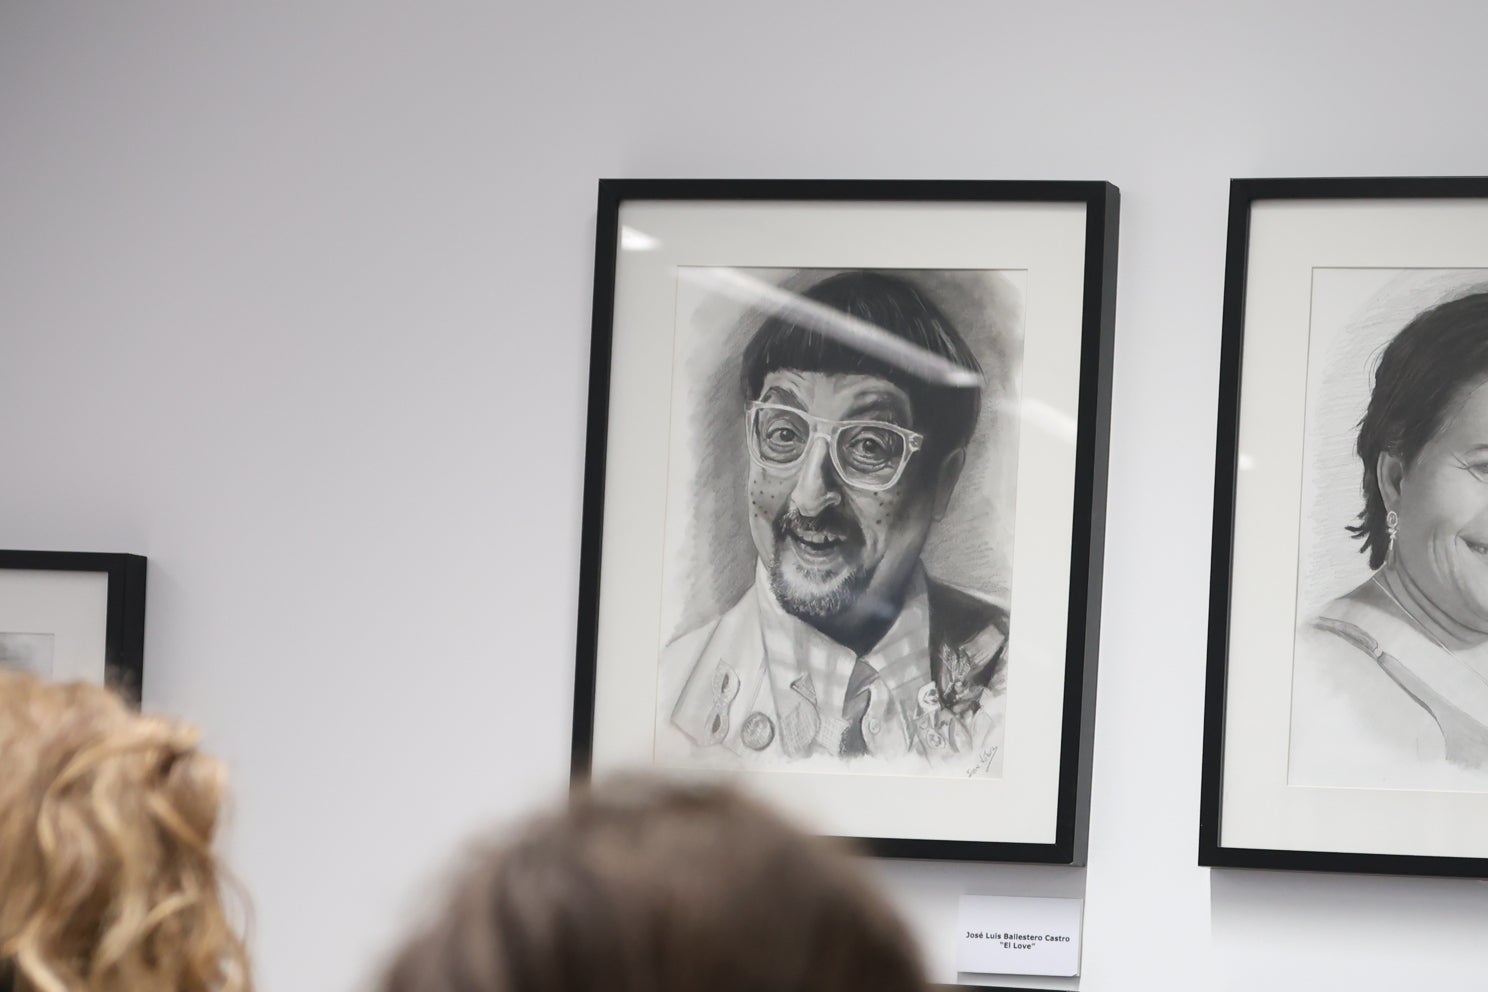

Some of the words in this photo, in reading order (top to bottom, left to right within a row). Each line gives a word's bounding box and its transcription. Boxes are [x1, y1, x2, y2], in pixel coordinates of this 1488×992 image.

[966, 931, 983, 939] José
[986, 932, 1001, 940] Luis
[1004, 933, 1043, 941] Ballestero
[1045, 934, 1071, 942] Castro
